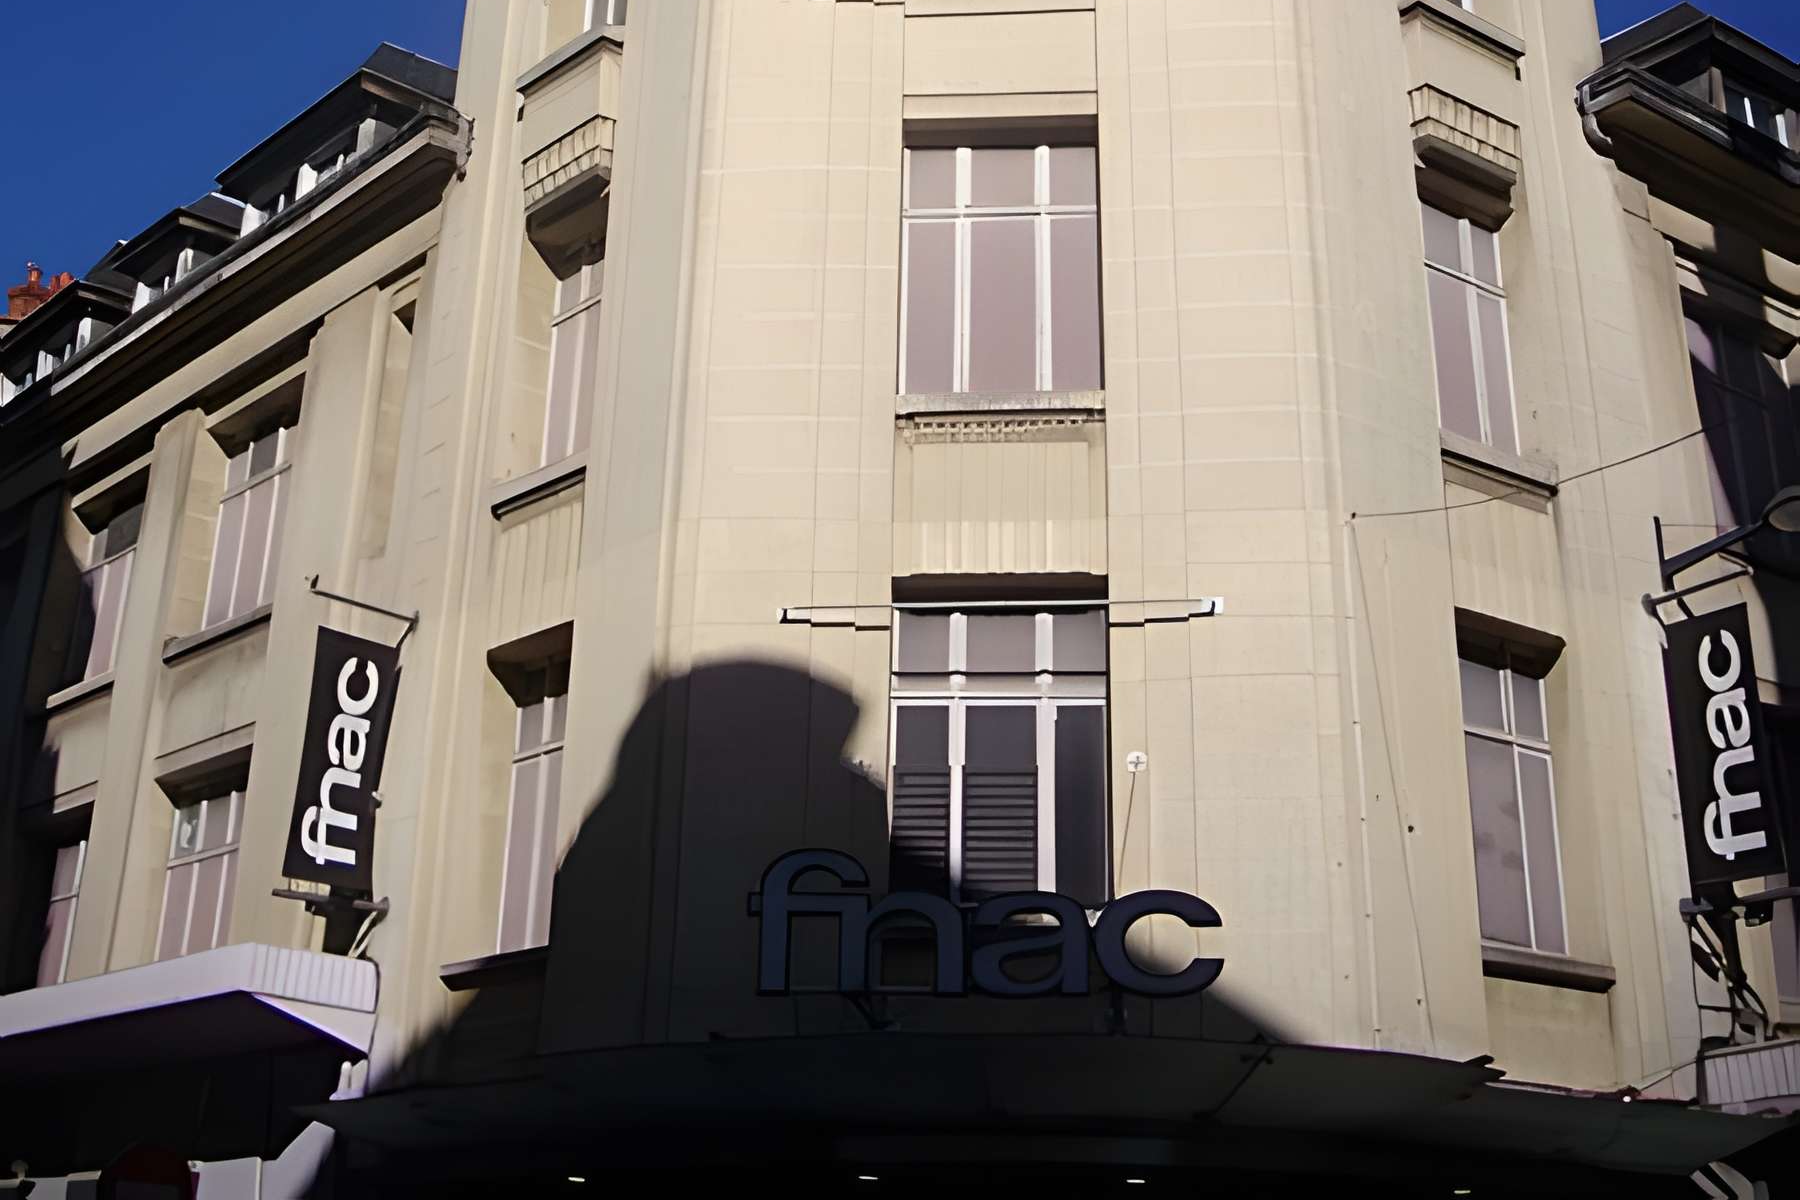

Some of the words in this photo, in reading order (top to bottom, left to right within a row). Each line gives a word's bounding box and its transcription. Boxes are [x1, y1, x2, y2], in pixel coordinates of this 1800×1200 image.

[301, 657, 379, 865] fnac
[1698, 629, 1768, 861] fnac
[747, 847, 1225, 997] fnac
